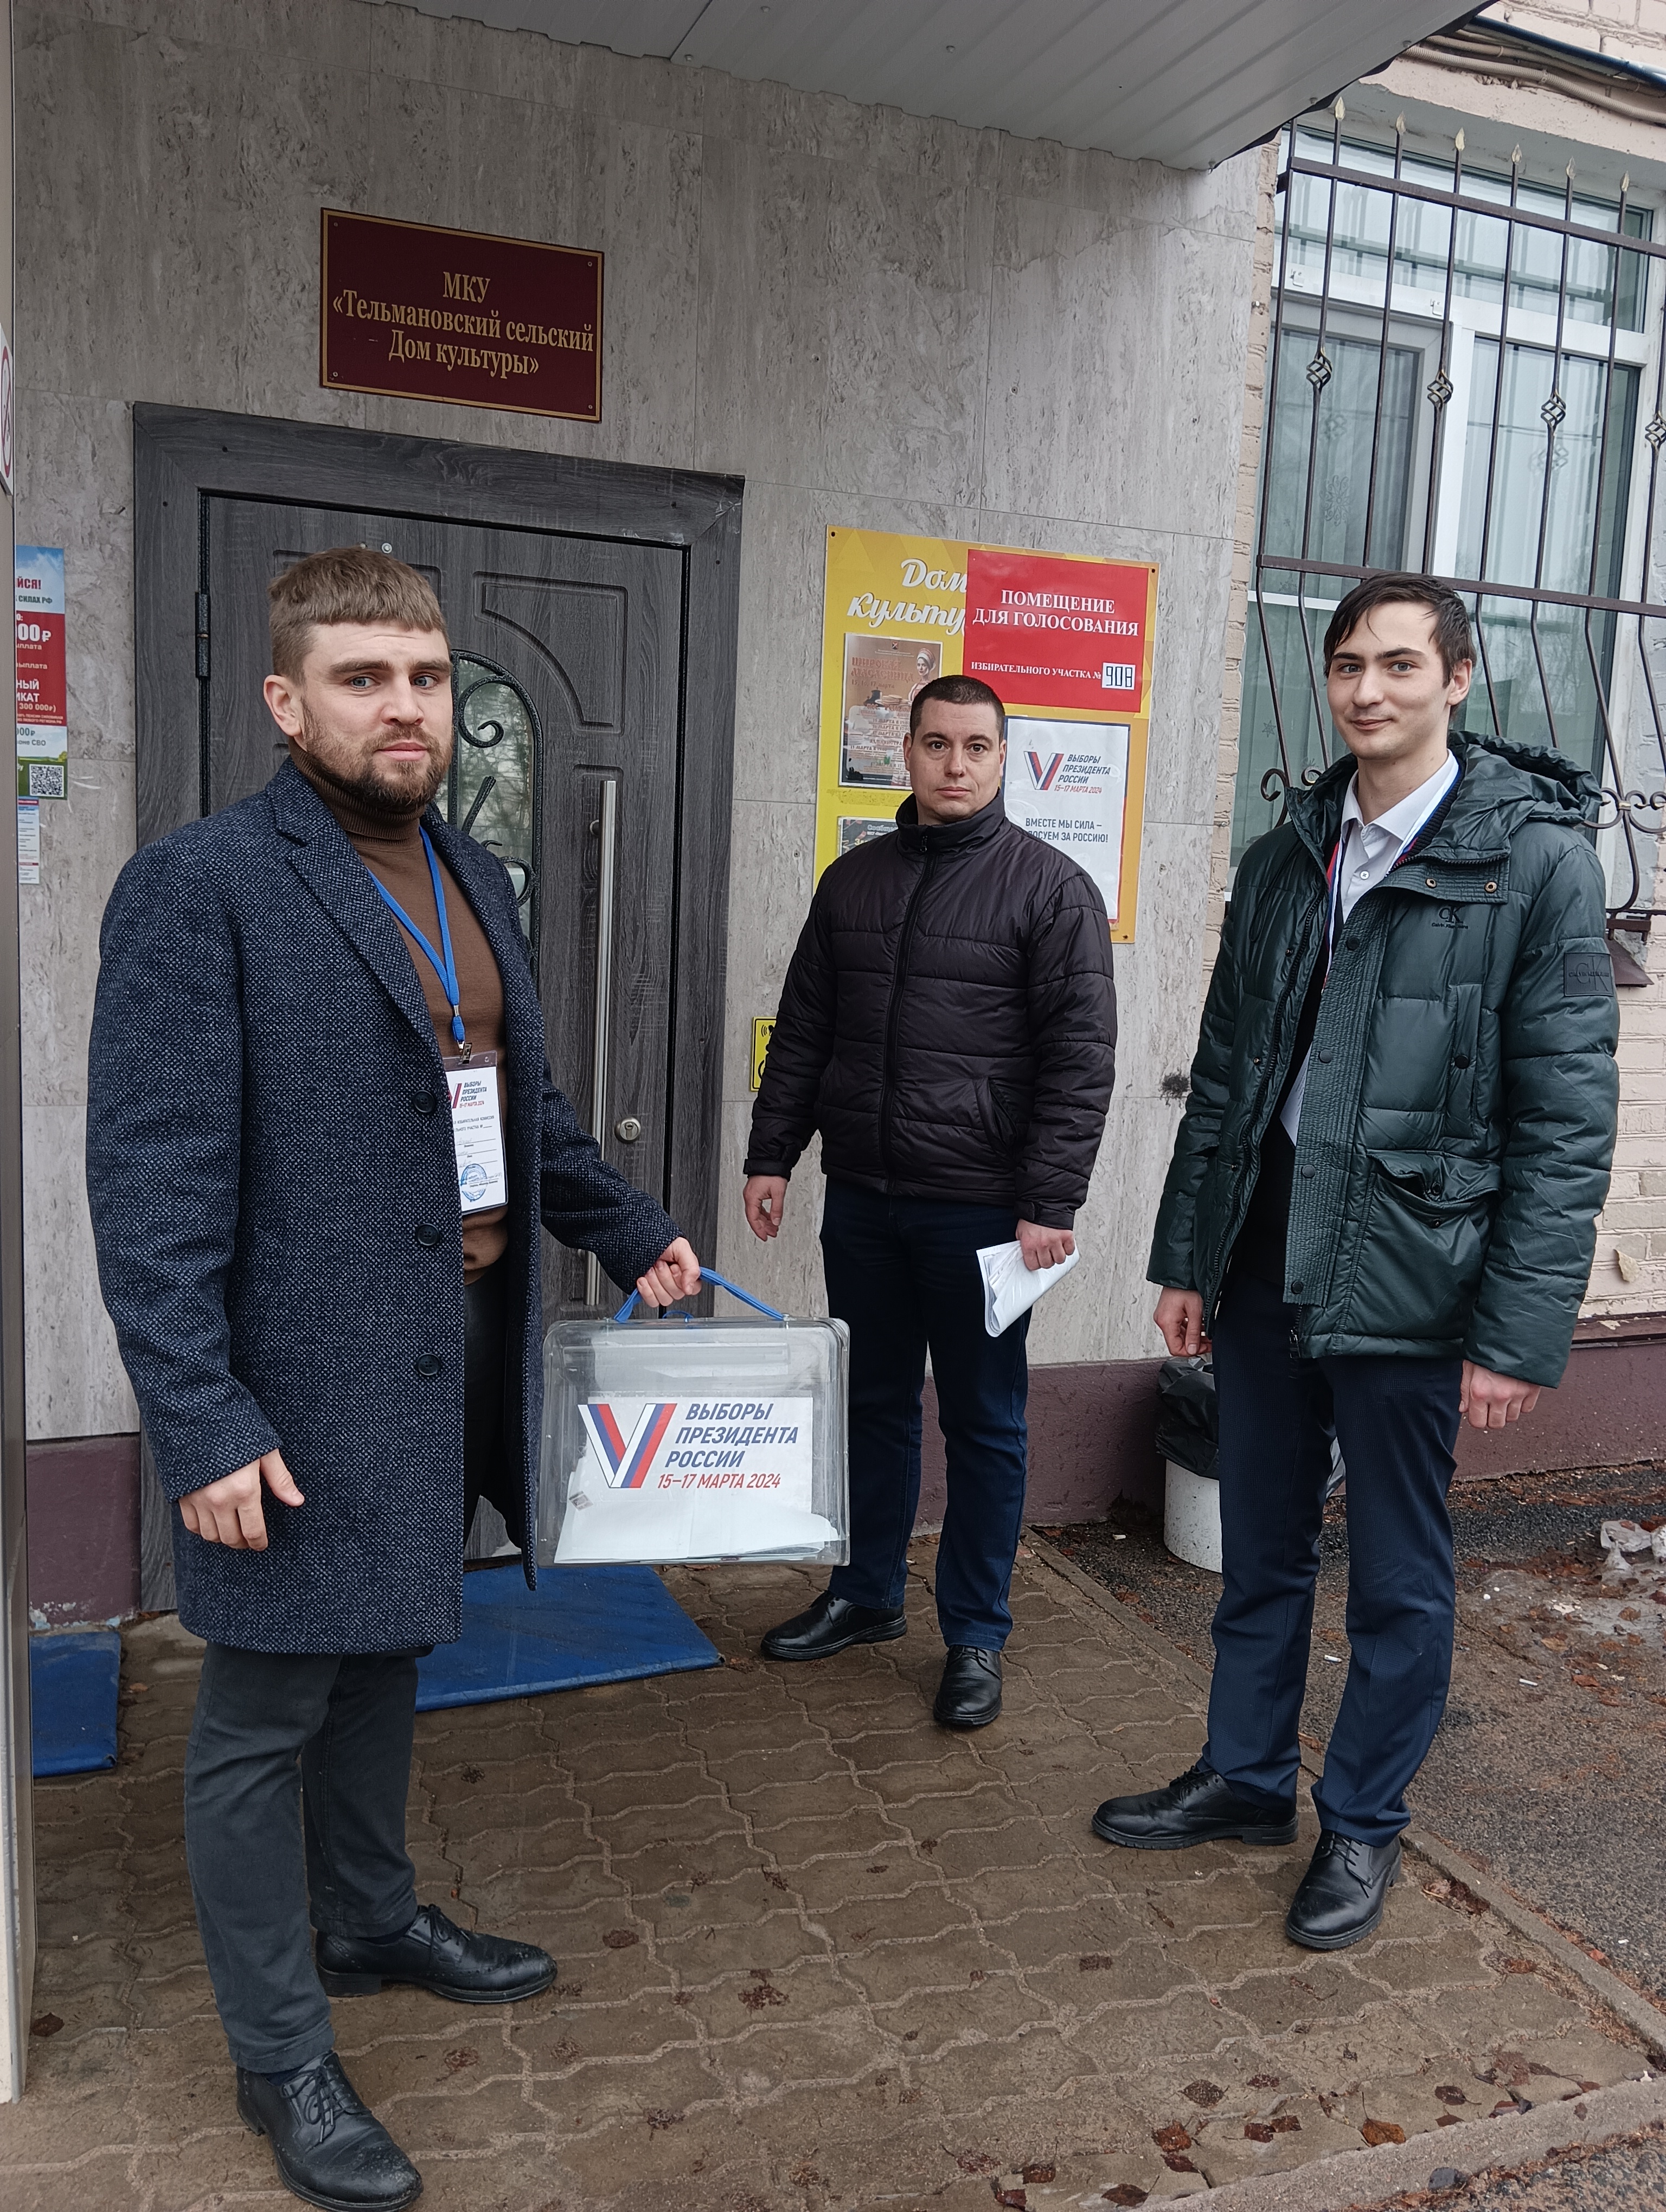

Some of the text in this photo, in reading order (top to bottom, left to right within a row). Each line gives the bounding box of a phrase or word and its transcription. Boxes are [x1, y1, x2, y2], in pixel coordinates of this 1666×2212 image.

[443, 272, 490, 303] МКУ
[332, 290, 594, 352] «Тельмановский сельский
[389, 330, 539, 379] Дом культуры»
[16, 576, 41, 590] ЙСЯ!
[901, 558, 967, 593] Дом
[18, 595, 41, 603] СИЛАХ
[1001, 589, 1114, 614] ПОМЕЩЕНИЕ
[847, 591, 966, 636] Культу
[973, 608, 1138, 636] ДЛЯ ГОЛОСОВАНИЯ
[971, 661, 1133, 687] ИЗБИРАТЕЛЬНОГО УЧАСТКА № 908
[1067, 754, 1101, 764] ВЫБОРЫ
[1062, 764, 1111, 775] ПРЕЗИДЕНТА
[1058, 774, 1089, 784] РОССИИ
[1026, 818, 1056, 828] ВМЕСТЕ
[1058, 819, 1073, 828] МЫ
[1074, 820, 1094, 829] СИЛА
[1061, 832, 1071, 841] ЗА
[1073, 832, 1108, 843] РОССИЮ!
[462, 1086, 487, 1095] ПРЕЗИДЕНТА
[685, 1403, 773, 1420] ВЫБОРЫ
[675, 1426, 798, 1446] ПРЕЗИДЕНТА
[665, 1450, 745, 1468] РОССИИ
[697, 1474, 745, 1489] МАРТА
[746, 1473, 781, 1489] 2024
